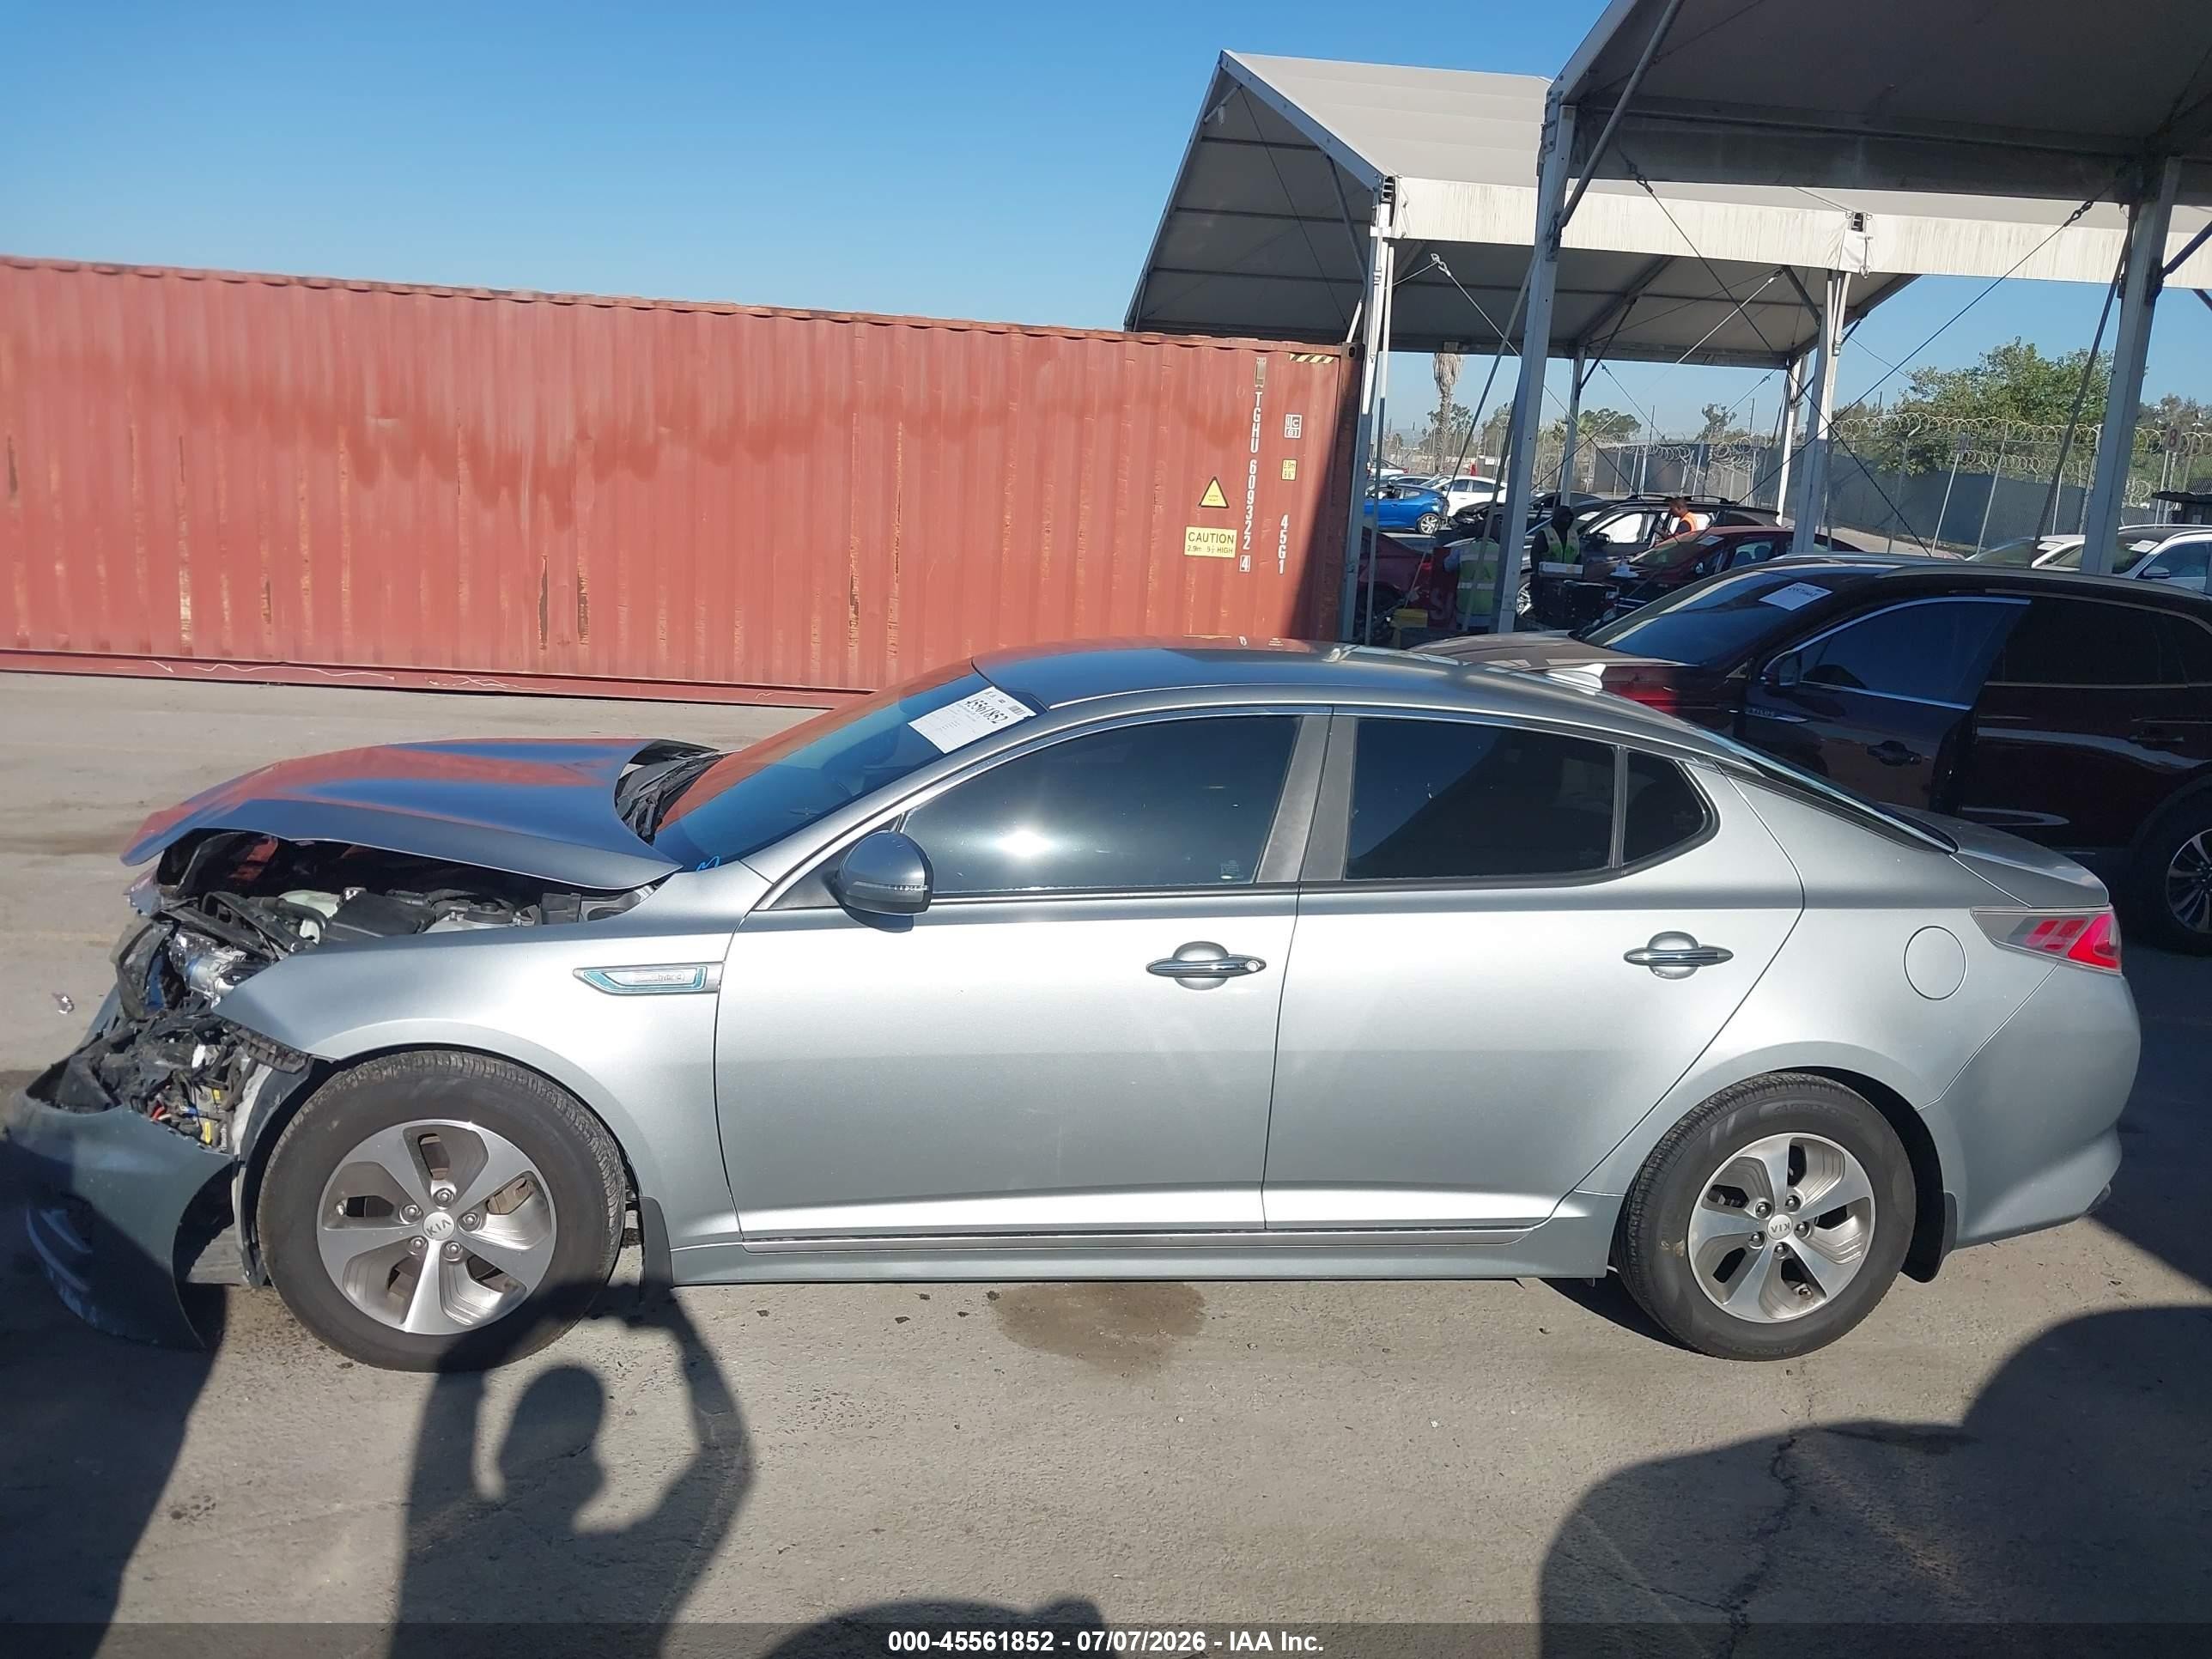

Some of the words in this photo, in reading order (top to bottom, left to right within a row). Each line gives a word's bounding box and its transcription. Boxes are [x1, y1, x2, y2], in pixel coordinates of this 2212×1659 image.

[1250, 391, 1263, 453] TGHU
[1243, 459, 1258, 550] 609322
[1188, 532, 1235, 544] CAUTION
[1278, 514, 1289, 574] 45G1
[964, 698, 1010, 725] 45561852
[426, 1218, 452, 1237] KIA
[1771, 1222, 1790, 1233] KIA
